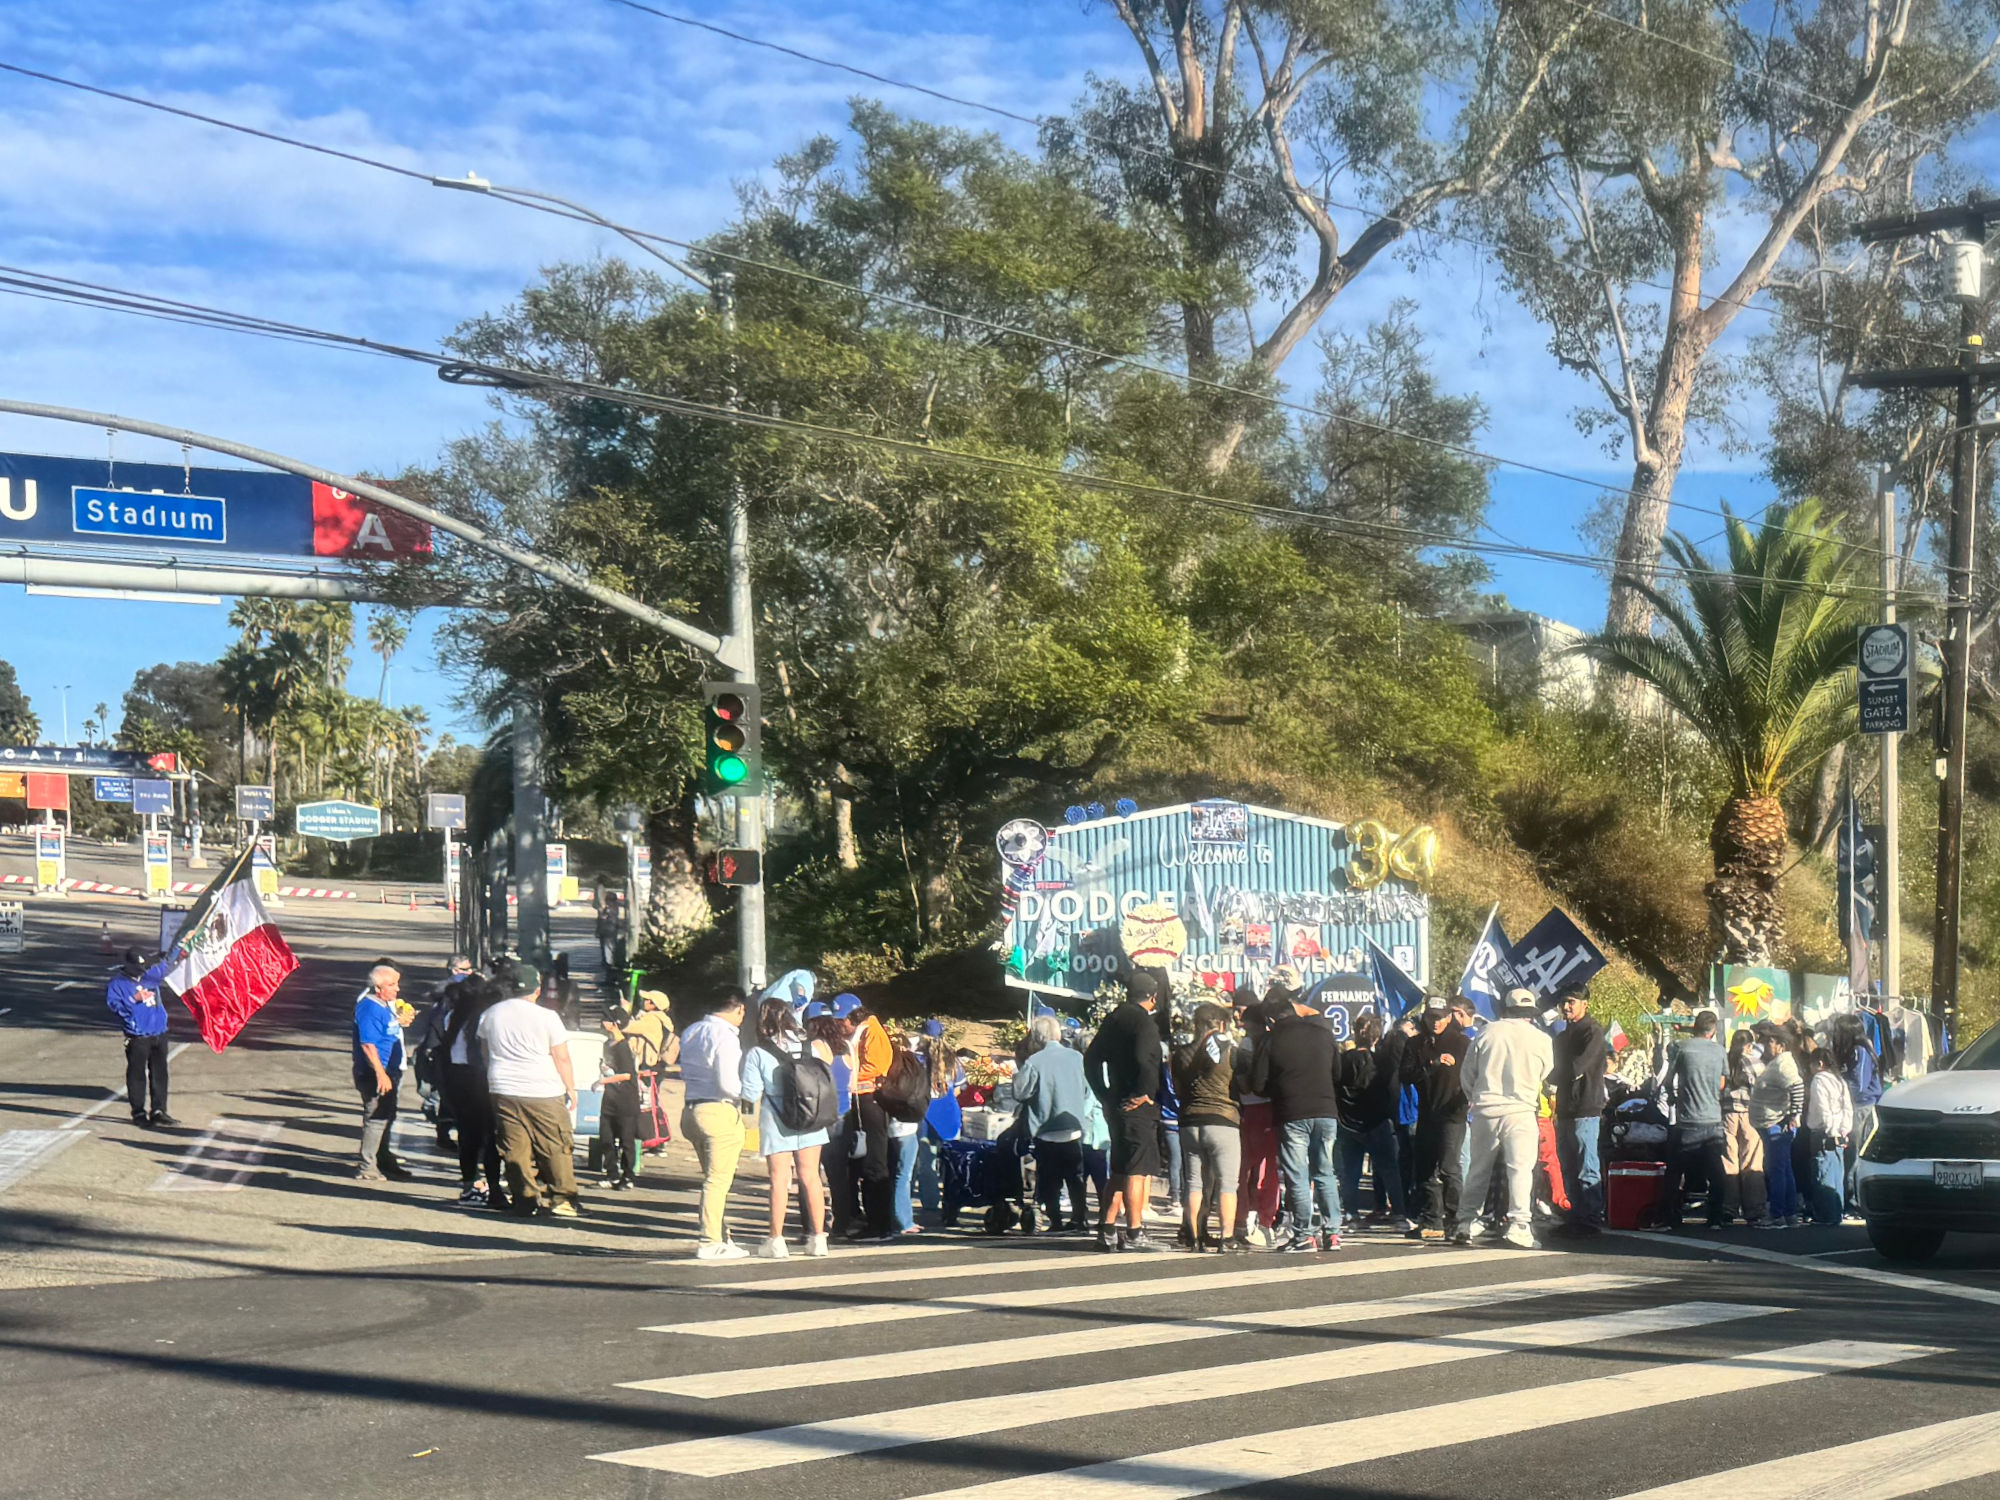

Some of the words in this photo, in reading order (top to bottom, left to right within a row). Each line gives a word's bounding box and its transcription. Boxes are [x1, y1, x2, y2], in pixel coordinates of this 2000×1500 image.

[87, 499, 213, 531] Stadium
[356, 512, 394, 552] A
[1865, 641, 1900, 659] STADIUM
[1864, 706, 1892, 719] GATE
[1894, 705, 1902, 717] A
[1867, 694, 1898, 705] SUNSET
[1159, 832, 1249, 868] Welcome
[1254, 839, 1273, 864] to
